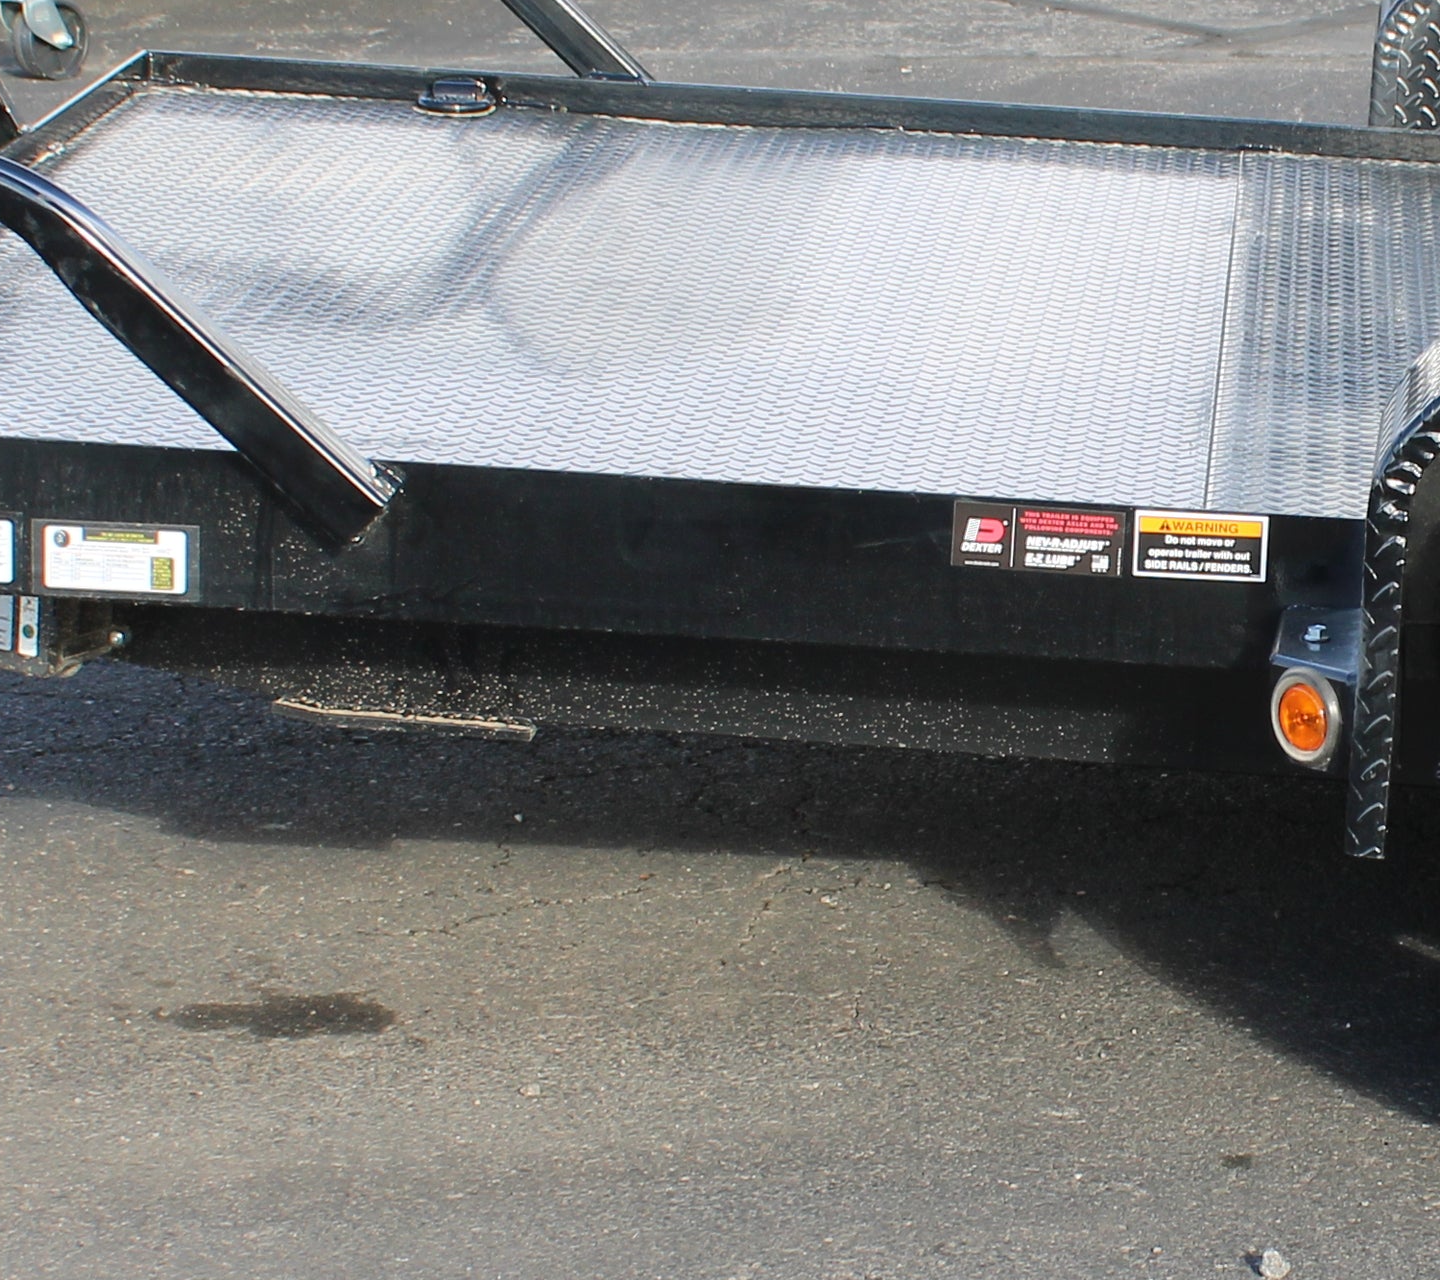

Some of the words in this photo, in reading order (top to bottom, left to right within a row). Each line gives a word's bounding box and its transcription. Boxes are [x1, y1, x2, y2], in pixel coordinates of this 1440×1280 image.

[1172, 520, 1239, 534] WARNING
[1165, 535, 1178, 545] Do
[1180, 536, 1196, 546] not
[1197, 538, 1223, 547] move
[1225, 539, 1235, 547] or
[960, 542, 1003, 554] DEXTER
[1148, 548, 1183, 559] operate
[1185, 548, 1212, 559] trailer
[1213, 549, 1233, 560] with
[1234, 551, 1251, 561] out
[1144, 559, 1167, 570] SIDE
[1169, 561, 1198, 572] RAILS
[1205, 563, 1253, 574] FENDERS.
